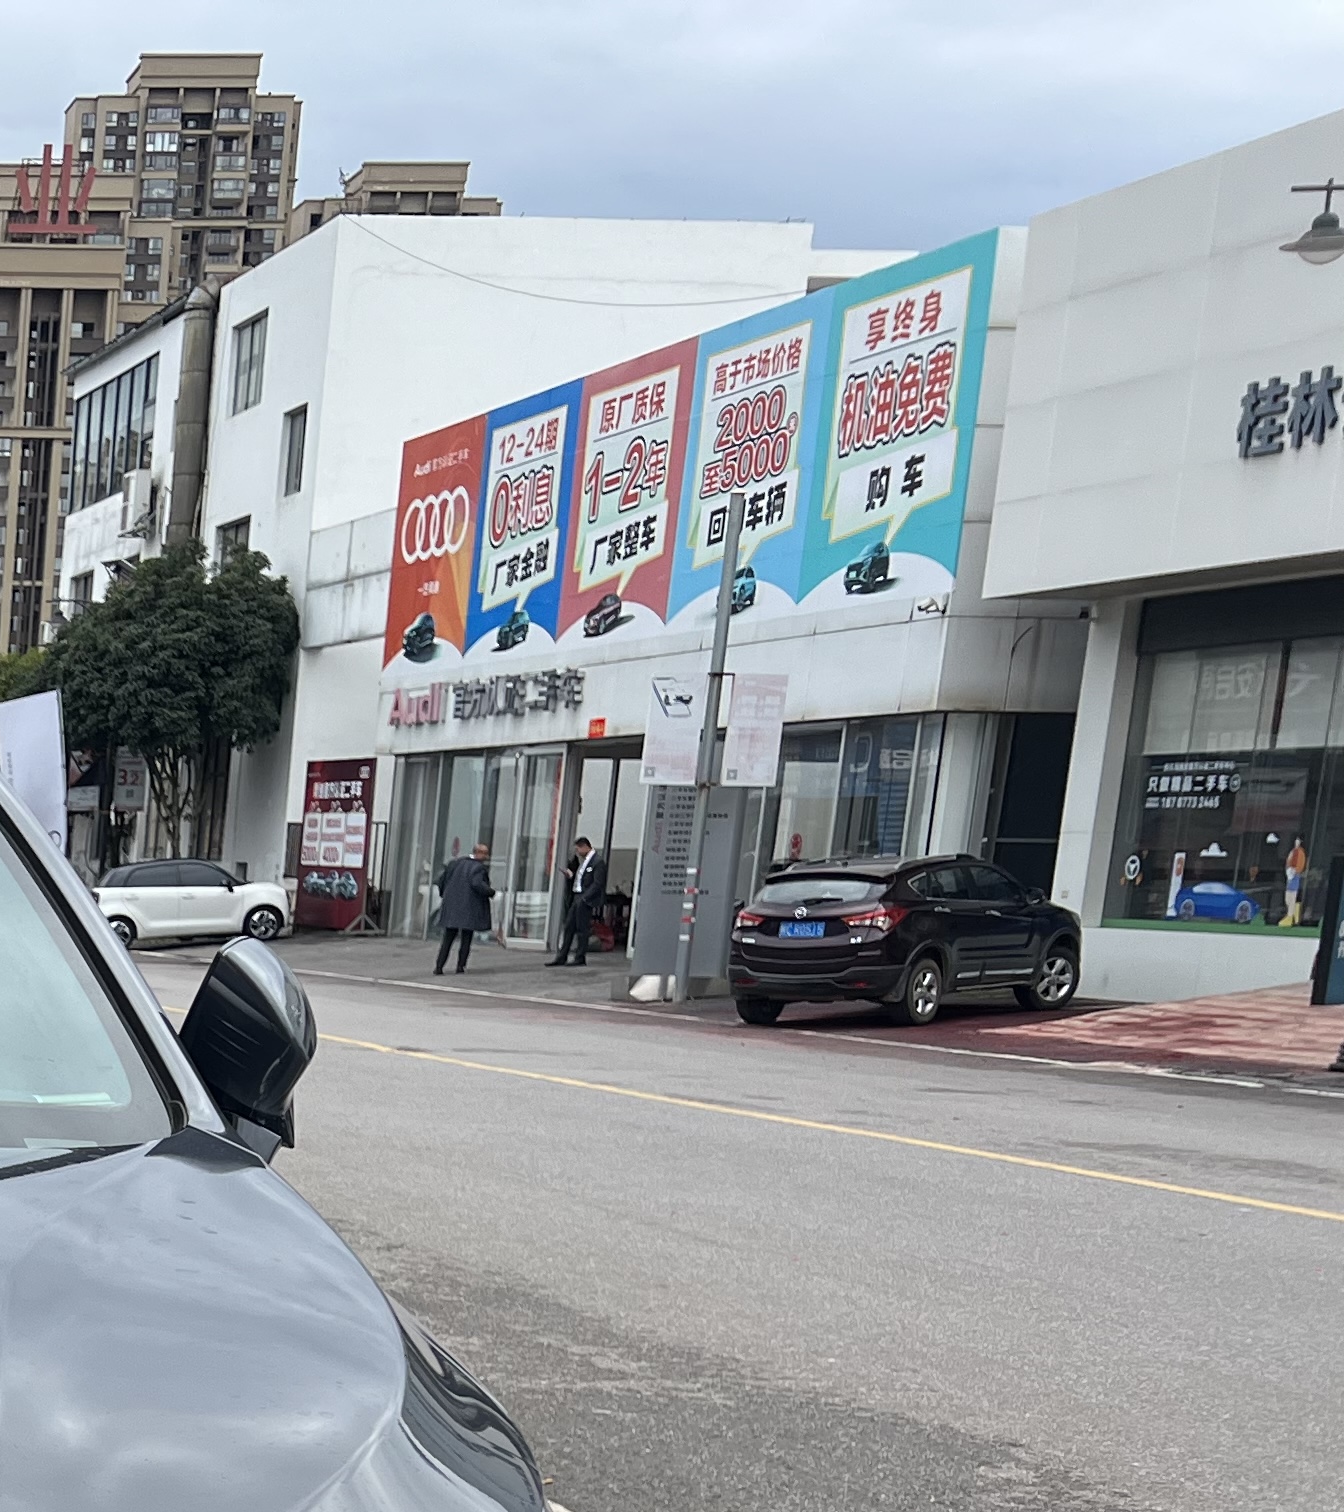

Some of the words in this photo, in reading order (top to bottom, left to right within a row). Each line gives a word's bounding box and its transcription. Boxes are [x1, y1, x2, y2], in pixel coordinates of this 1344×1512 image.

[865, 290, 941, 350] 享终身
[713, 337, 802, 395] 高于市场价格
[600, 381, 666, 434] 原厂质保
[714, 384, 787, 453] 2000
[838, 341, 956, 458] 机油免费
[1237, 364, 1344, 459] 桂林
[499, 417, 559, 465] 12-24期
[700, 427, 792, 499] 至5000
[489, 465, 554, 549] 0利息
[585, 436, 668, 524] 1-2年
[590, 515, 657, 575] 厂家整车
[706, 481, 788, 547] 回车辆
[491, 538, 550, 595] 厂家金融
[388, 682, 444, 727] Audi
